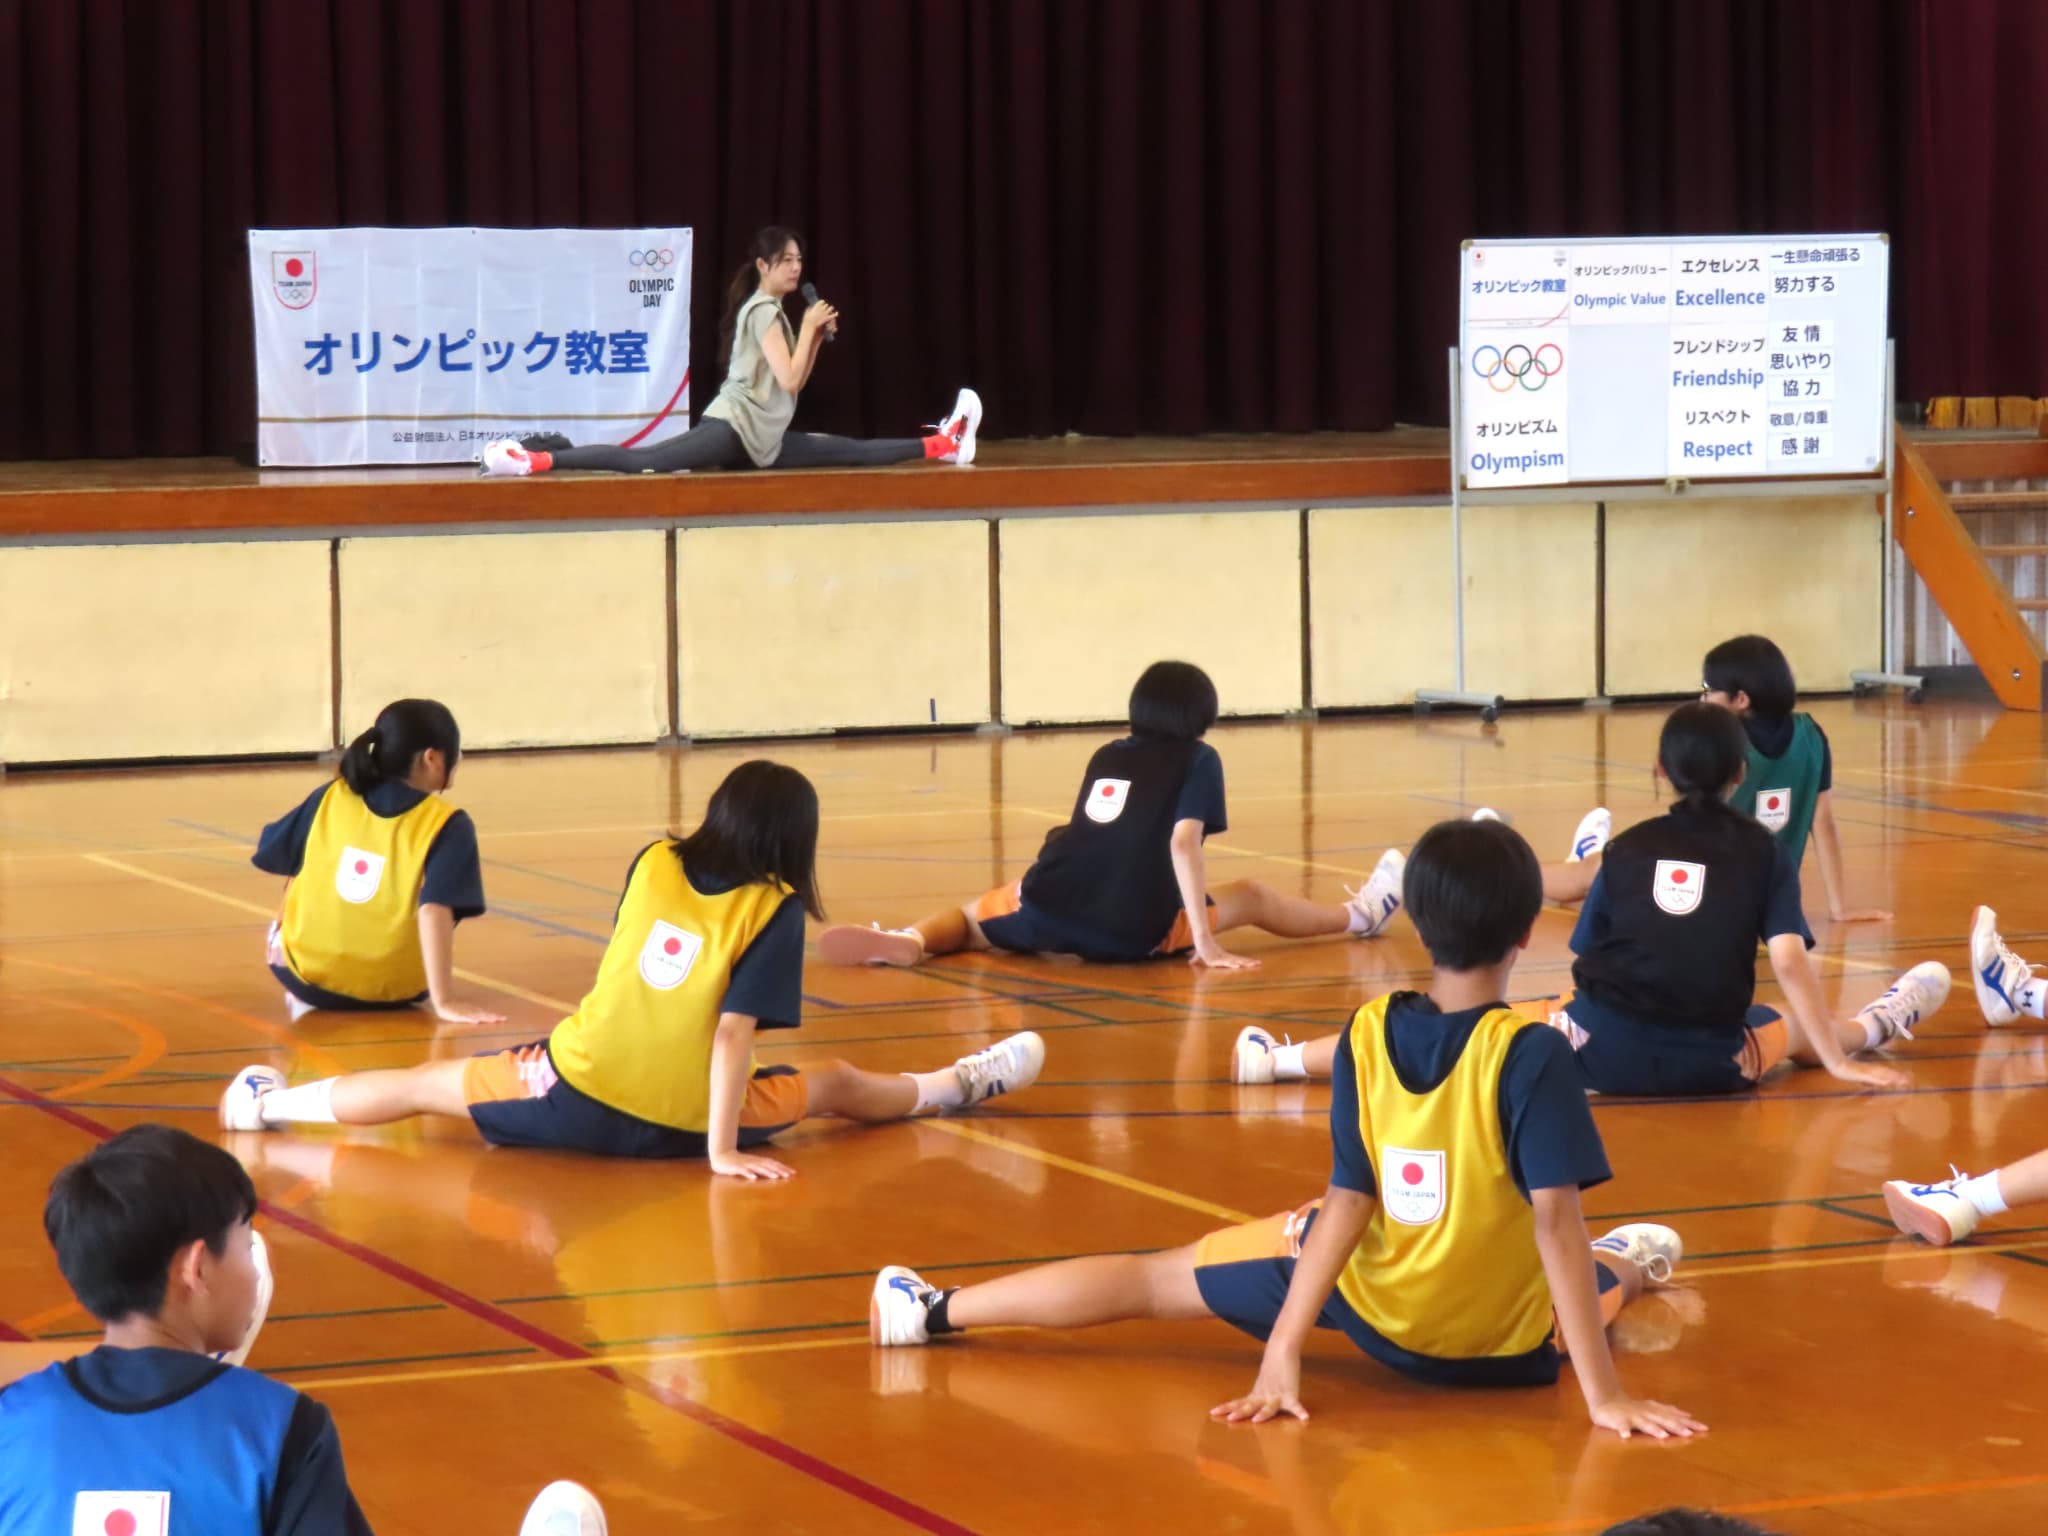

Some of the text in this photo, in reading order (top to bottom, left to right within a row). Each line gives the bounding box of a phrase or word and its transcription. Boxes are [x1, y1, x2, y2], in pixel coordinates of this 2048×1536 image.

[1681, 257, 1760, 273] エクセレンス
[1770, 247, 1862, 265] 一生懸命頑張る
[629, 278, 675, 293] OLYMPIC
[1471, 278, 1567, 294] オリンピック教室
[1774, 275, 1836, 294] 努力する
[643, 294, 662, 308] DAY
[1574, 292, 1667, 309] Olympic Value
[1675, 288, 1766, 306] Excellence
[303, 328, 651, 376] オリンピック教室
[1672, 337, 1766, 355] フレンドシップ
[1770, 352, 1832, 370] 思いやり
[1672, 368, 1765, 389] Friendship
[1683, 440, 1754, 461] Respect
[1470, 450, 1565, 475] Olympism
[1413, 1190, 1437, 1199] JAPAN
